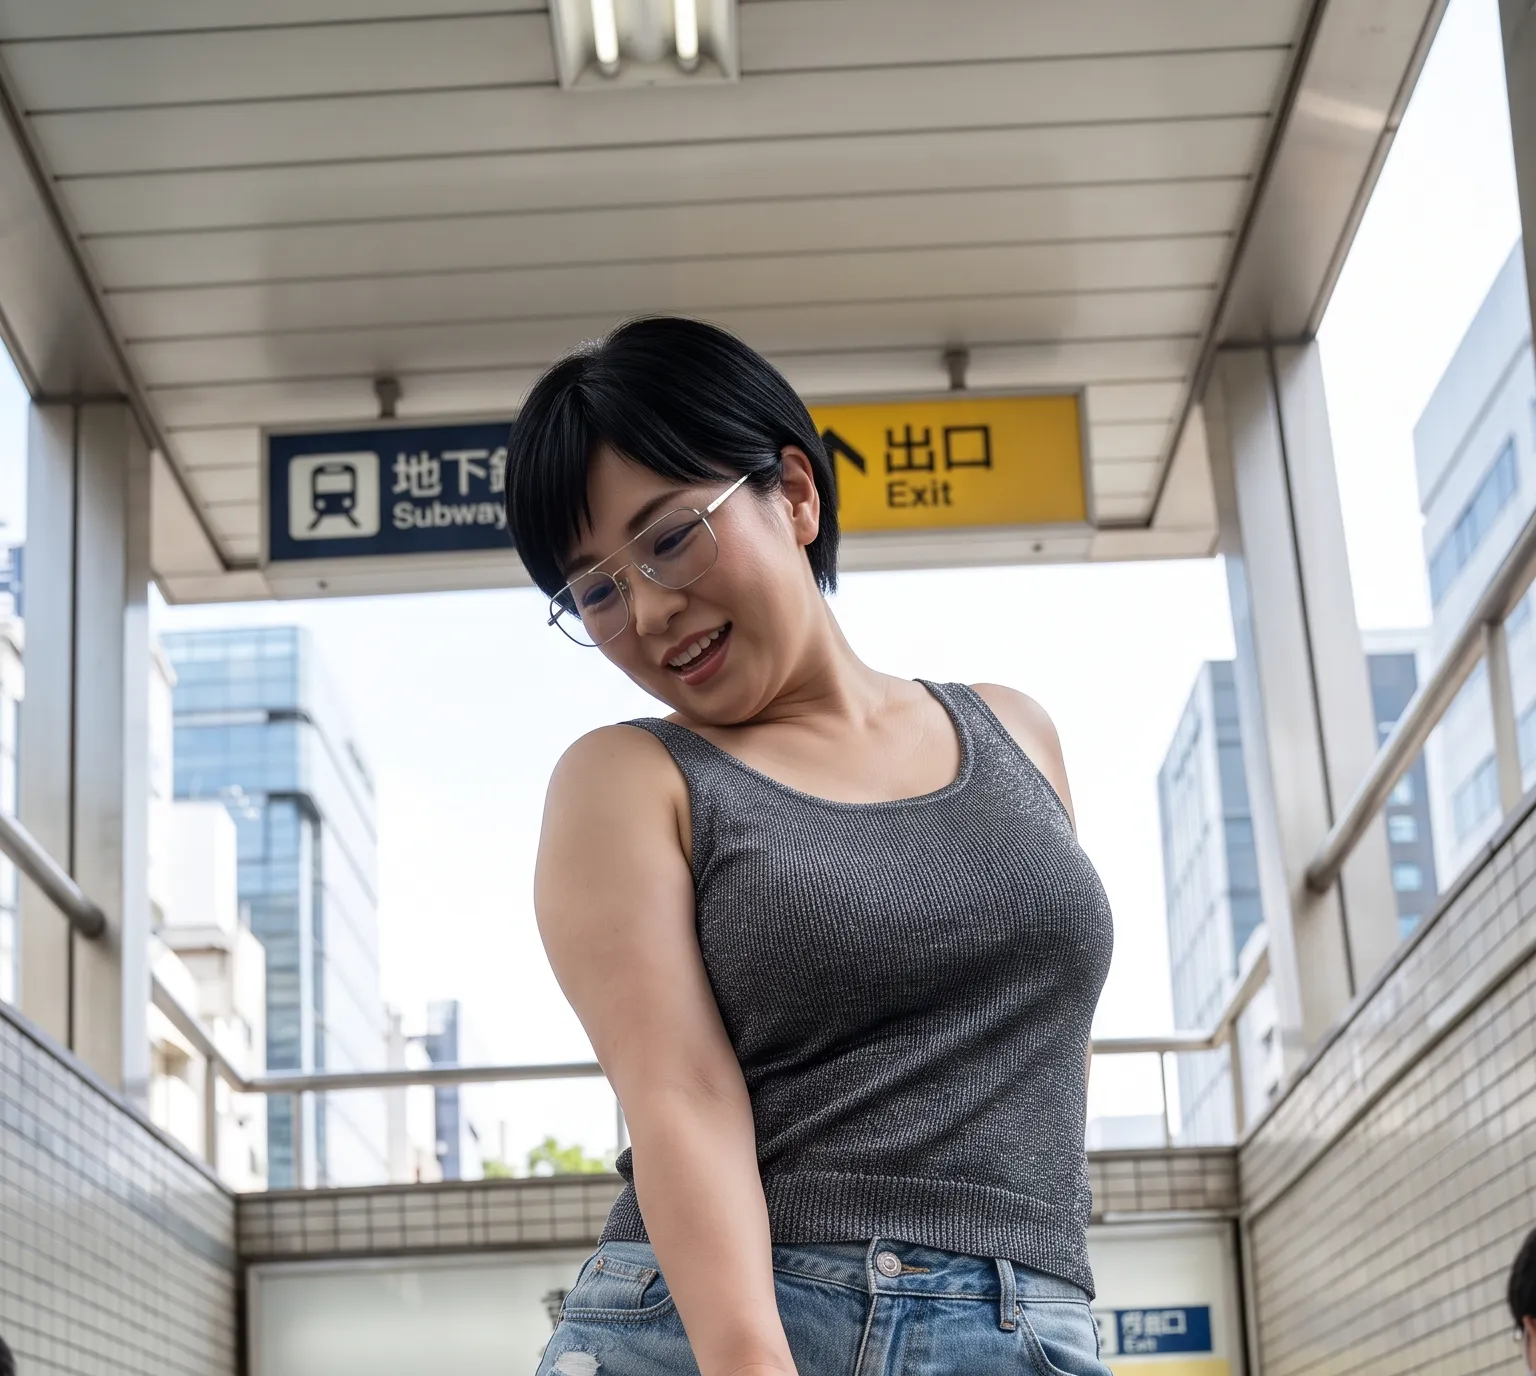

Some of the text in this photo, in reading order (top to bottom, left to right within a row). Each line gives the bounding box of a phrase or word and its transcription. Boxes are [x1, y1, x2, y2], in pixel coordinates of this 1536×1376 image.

[884, 423, 993, 474] 出口
[886, 480, 953, 508] Exit
[392, 500, 507, 530] Subway
